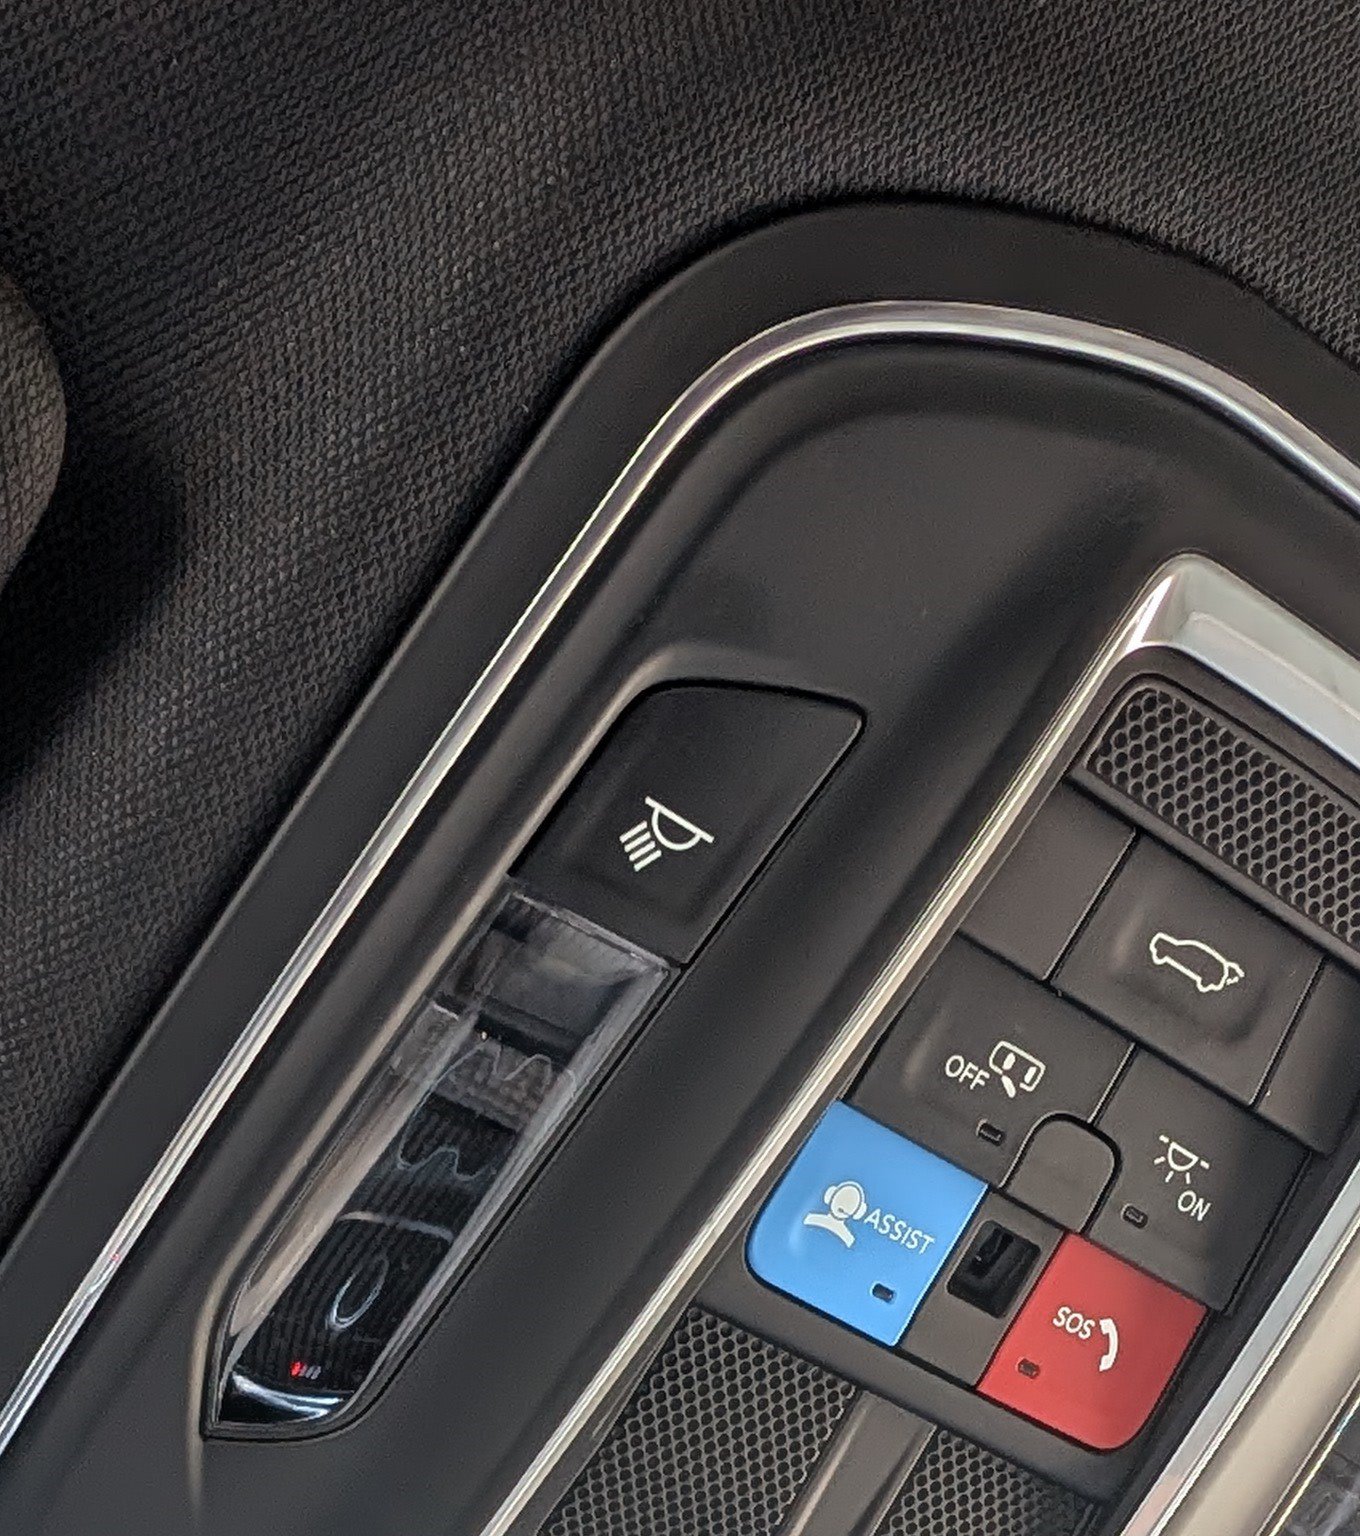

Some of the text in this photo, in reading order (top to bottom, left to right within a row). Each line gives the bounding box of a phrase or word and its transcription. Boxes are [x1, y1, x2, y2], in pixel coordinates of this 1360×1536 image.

[945, 1054, 990, 1090] OFF
[1177, 1189, 1211, 1221] ON
[863, 1208, 936, 1255] ASSIST
[1052, 1306, 1096, 1340] SOS
